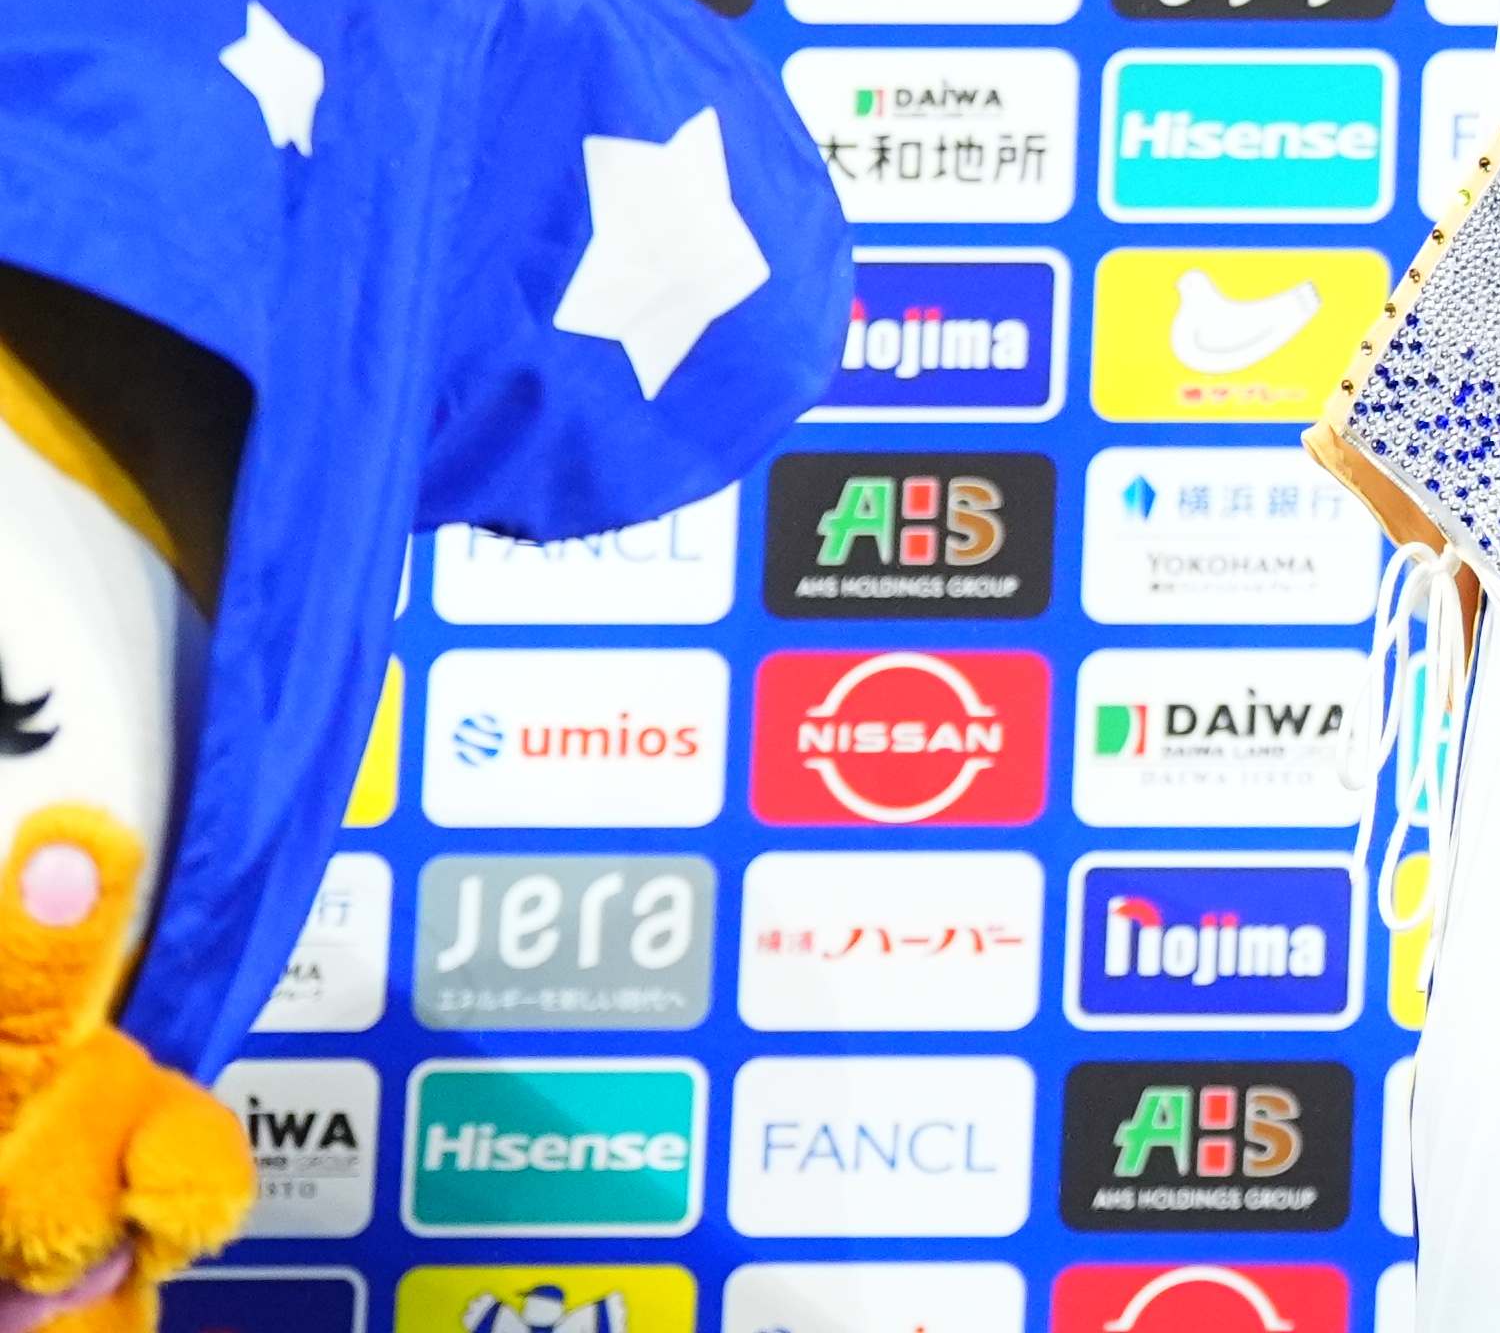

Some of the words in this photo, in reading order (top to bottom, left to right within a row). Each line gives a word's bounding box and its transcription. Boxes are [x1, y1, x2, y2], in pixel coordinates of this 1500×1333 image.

[1123, 114, 1385, 158] Hisense
[949, 576, 1019, 598] GROUP
[521, 713, 698, 757] umios
[798, 722, 1002, 753] NISSAN
[428, 1125, 694, 1172] Hisense
[760, 1120, 996, 1173] FANCL
